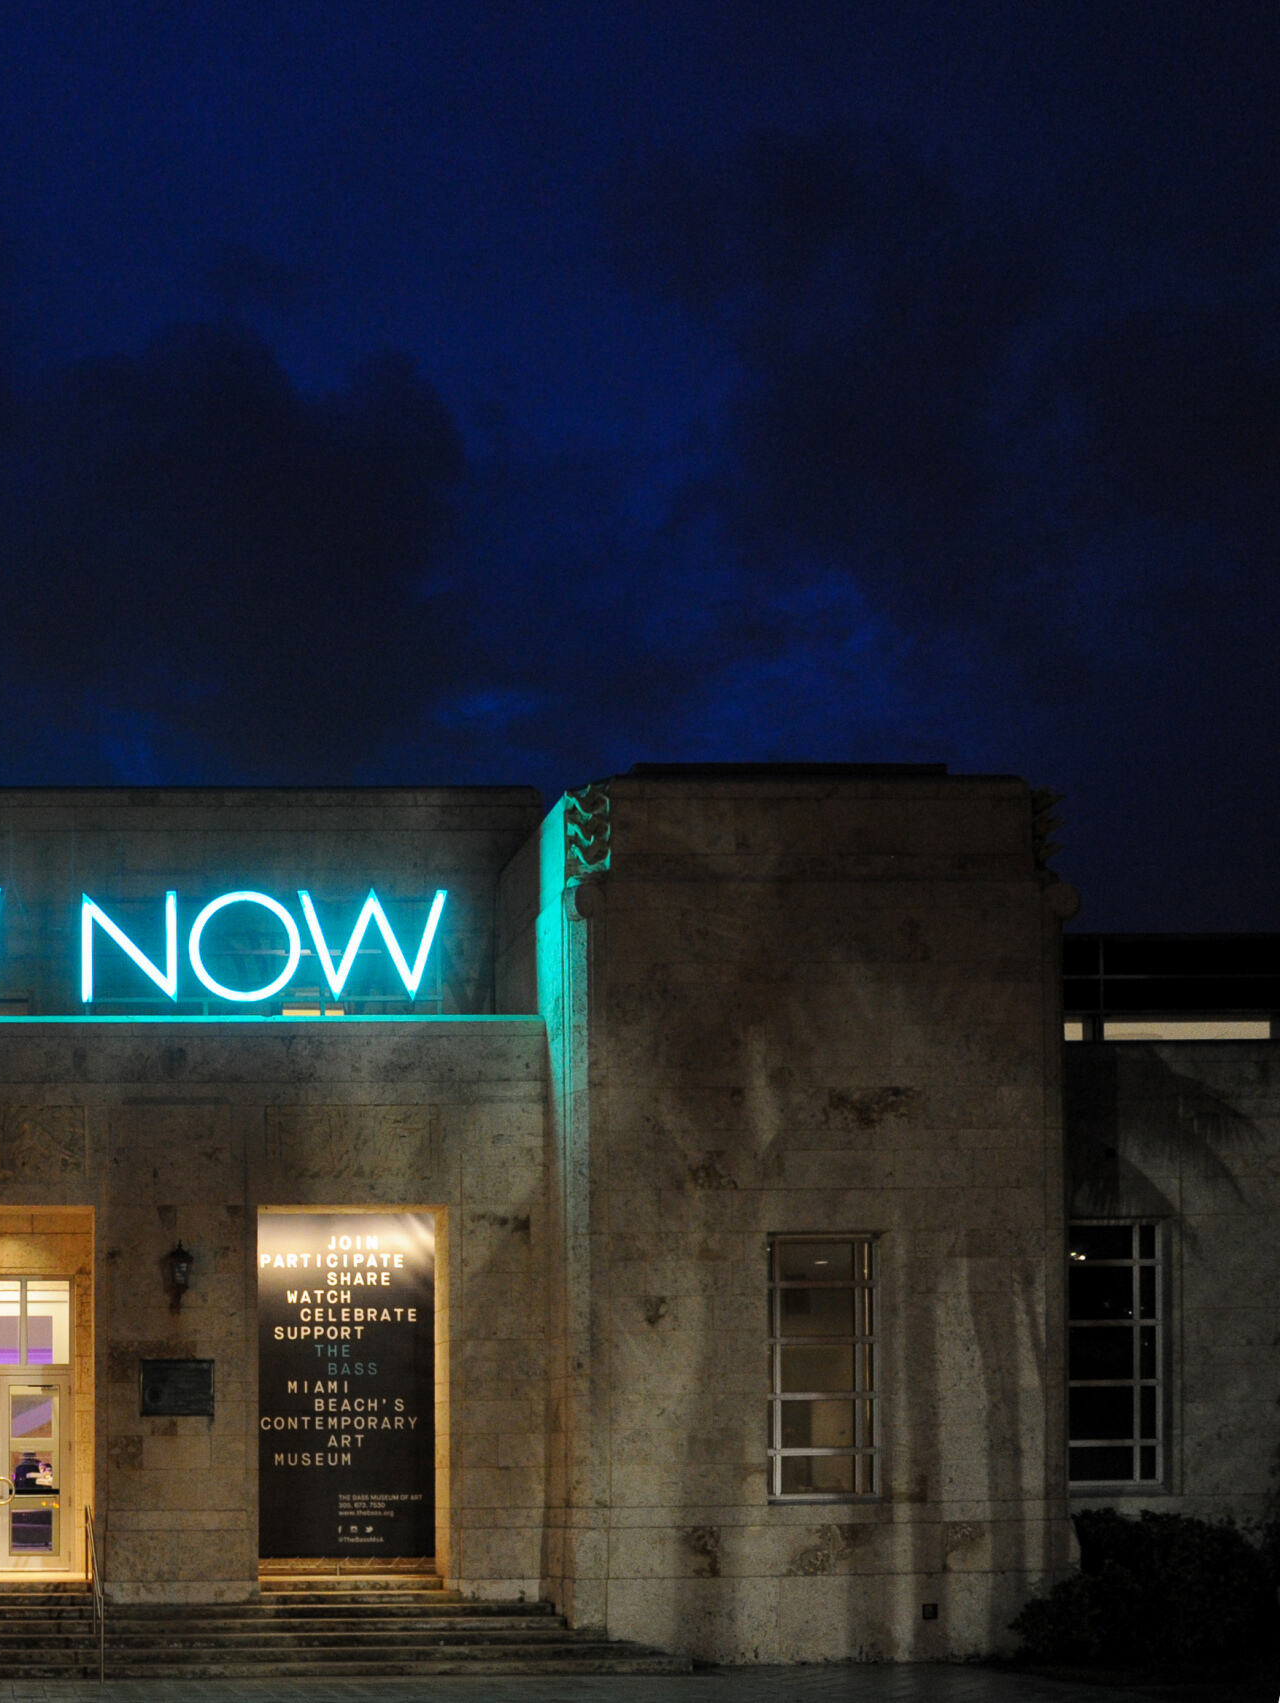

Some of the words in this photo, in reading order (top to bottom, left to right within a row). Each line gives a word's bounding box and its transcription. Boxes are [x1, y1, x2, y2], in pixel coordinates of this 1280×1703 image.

[81, 888, 448, 1002] NOW
[328, 1236, 379, 1250] JOIN
[260, 1254, 404, 1268] PARTICIPATE
[327, 1272, 391, 1286] SHARE
[287, 1290, 351, 1304] WATCH
[300, 1308, 417, 1322] CELEBRATE
[274, 1326, 364, 1340] SUPPORT
[315, 1345, 351, 1358] THE
[328, 1363, 378, 1376] BASS
[288, 1381, 348, 1394] MIAMI
[314, 1399, 405, 1412] BEACH'S
[260, 1417, 418, 1430] CONTEMPORARY
[328, 1435, 364, 1448] ART
[274, 1453, 352, 1466] MUSEUM
